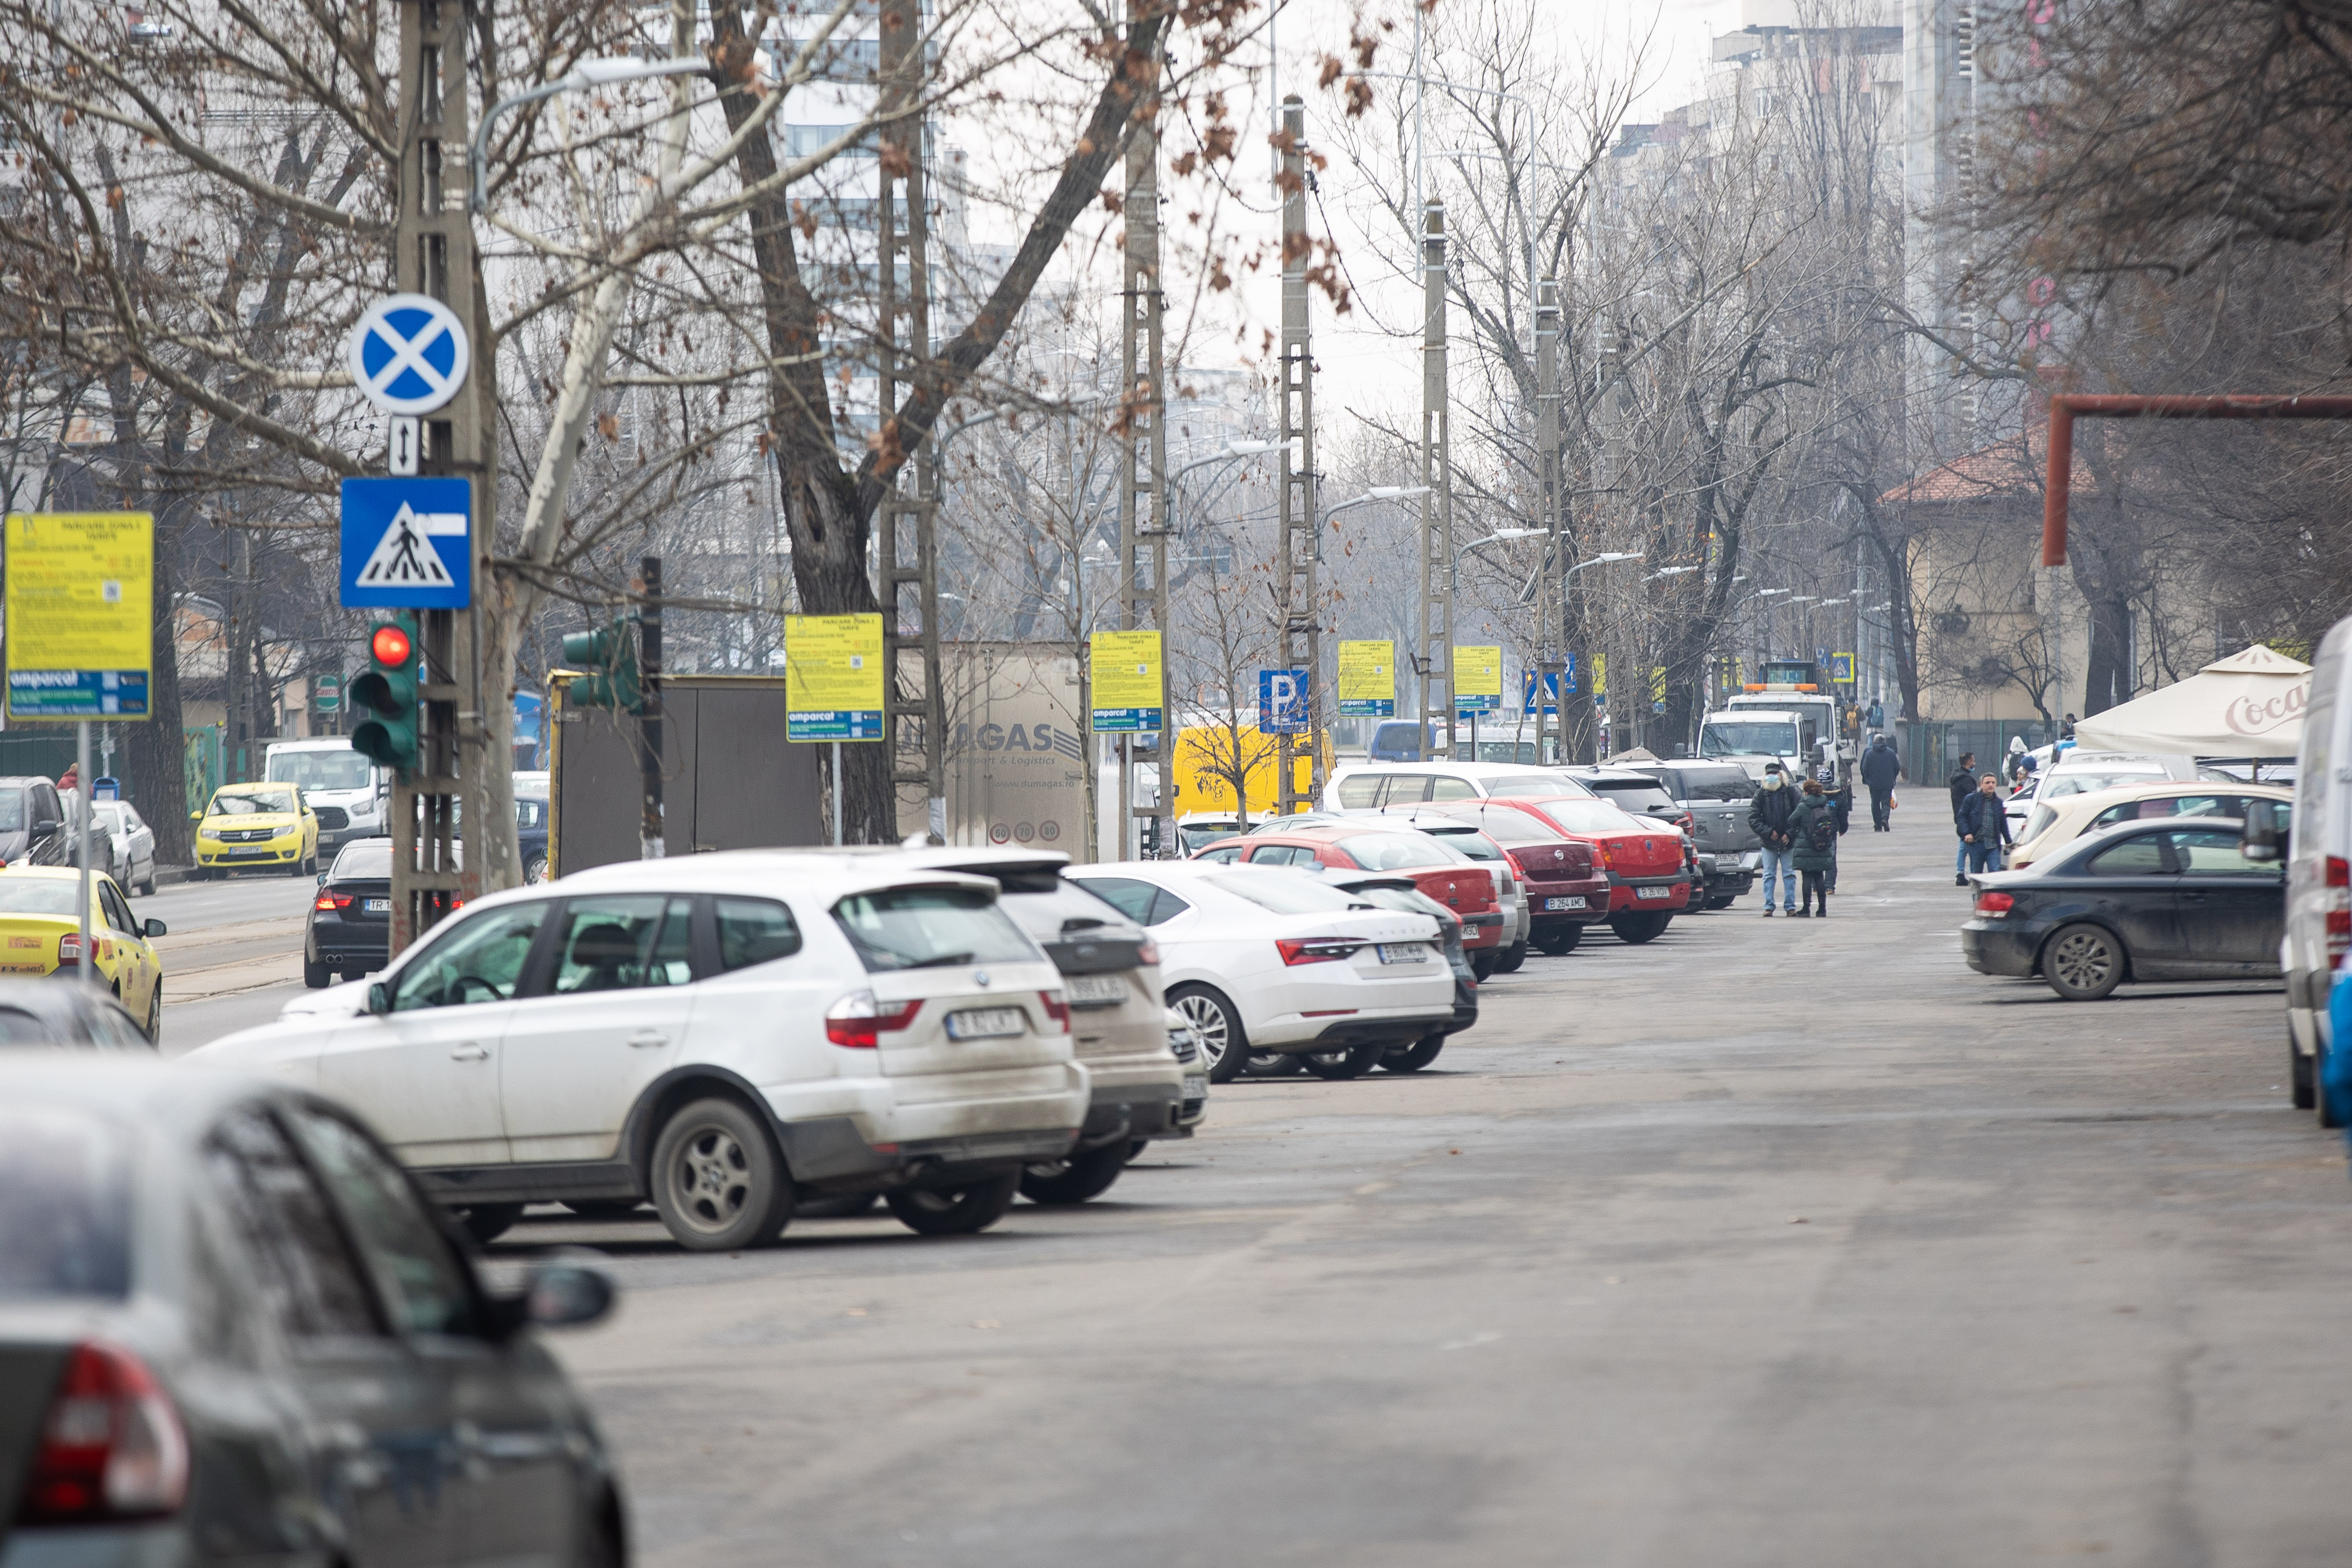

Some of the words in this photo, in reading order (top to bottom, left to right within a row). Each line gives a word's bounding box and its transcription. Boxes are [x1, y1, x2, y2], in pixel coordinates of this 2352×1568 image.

[1271, 675, 1296, 725] P
[1093, 709, 1127, 718] amparcat
[999, 756, 1006, 764] &
[1011, 755, 1056, 768] Logistics
[994, 779, 1075, 790] www.dumagas.ro
[995, 829, 1006, 838] 50
[1019, 828, 1030, 837] 70
[1045, 826, 1055, 835] 80
[1642, 888, 1647, 896] B
[370, 900, 383, 910] TR
[1549, 899, 1555, 909] B
[1557, 899, 1570, 908] 264
[1570, 897, 1584, 908] AMD
